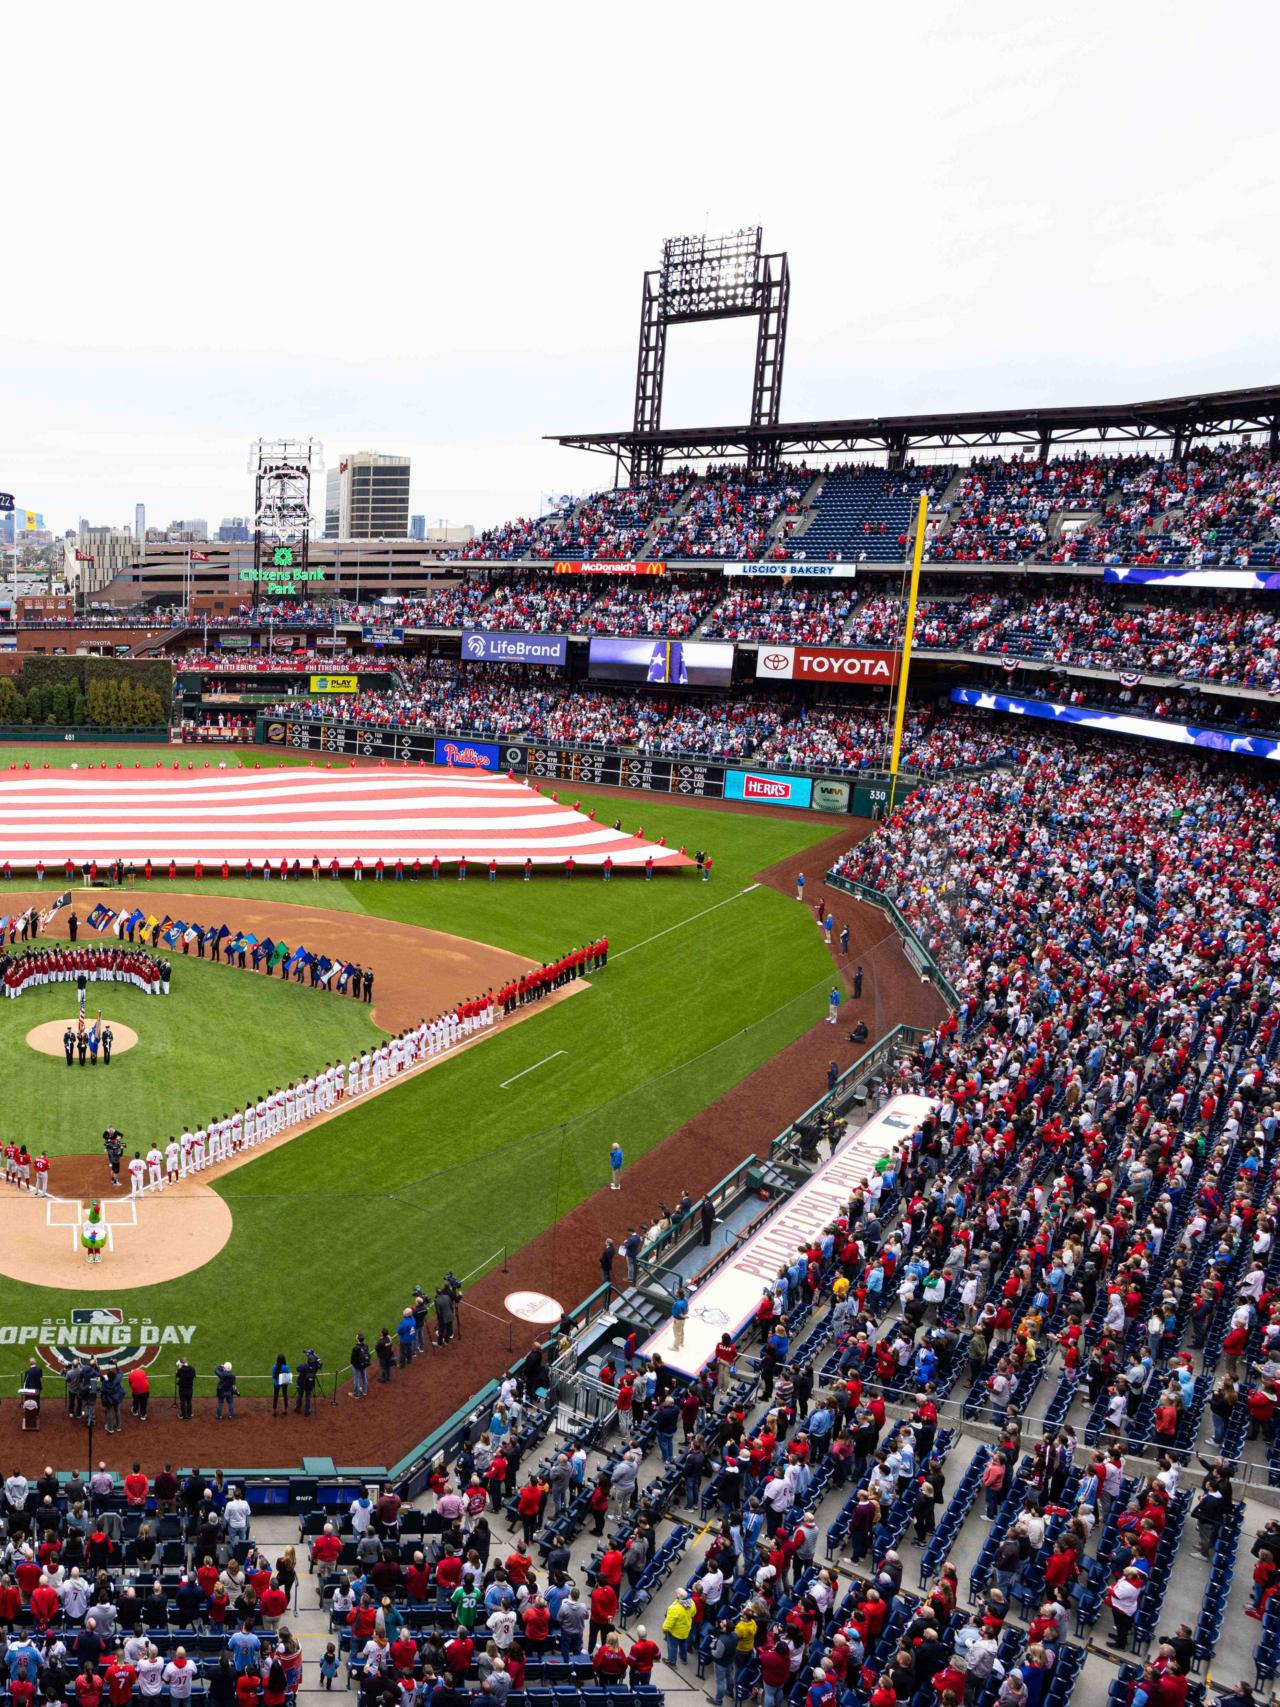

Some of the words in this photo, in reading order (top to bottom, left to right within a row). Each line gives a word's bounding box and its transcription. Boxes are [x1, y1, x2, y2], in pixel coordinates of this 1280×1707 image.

[581, 563, 637, 573] McDonald's
[742, 565, 787, 574] LISCIO'S
[790, 566, 834, 575] BAKERY
[240, 568, 291, 581] Citizens
[293, 568, 326, 581] Bank
[268, 582, 297, 595] Park
[490, 640, 561, 657] LifeBrand
[799, 655, 890, 677] TOYOTA
[444, 744, 490, 766] Phillies
[748, 780, 786, 797] HERR'S
[820, 786, 843, 796] WM
[869, 790, 886, 801] 330
[734, 1190, 848, 1281] PHILADELPHIA
[822, 1141, 889, 1188] PHILLIES
[140, 1325, 197, 1345] DAY
[462, 1597, 476, 1608] 20
[503, 1624, 509, 1634] 3
[376, 1653, 382, 1663] 3
[150, 1673, 156, 1683] 3
[119, 1679, 125, 1689] 7
[408, 1693, 413, 1702] 7
